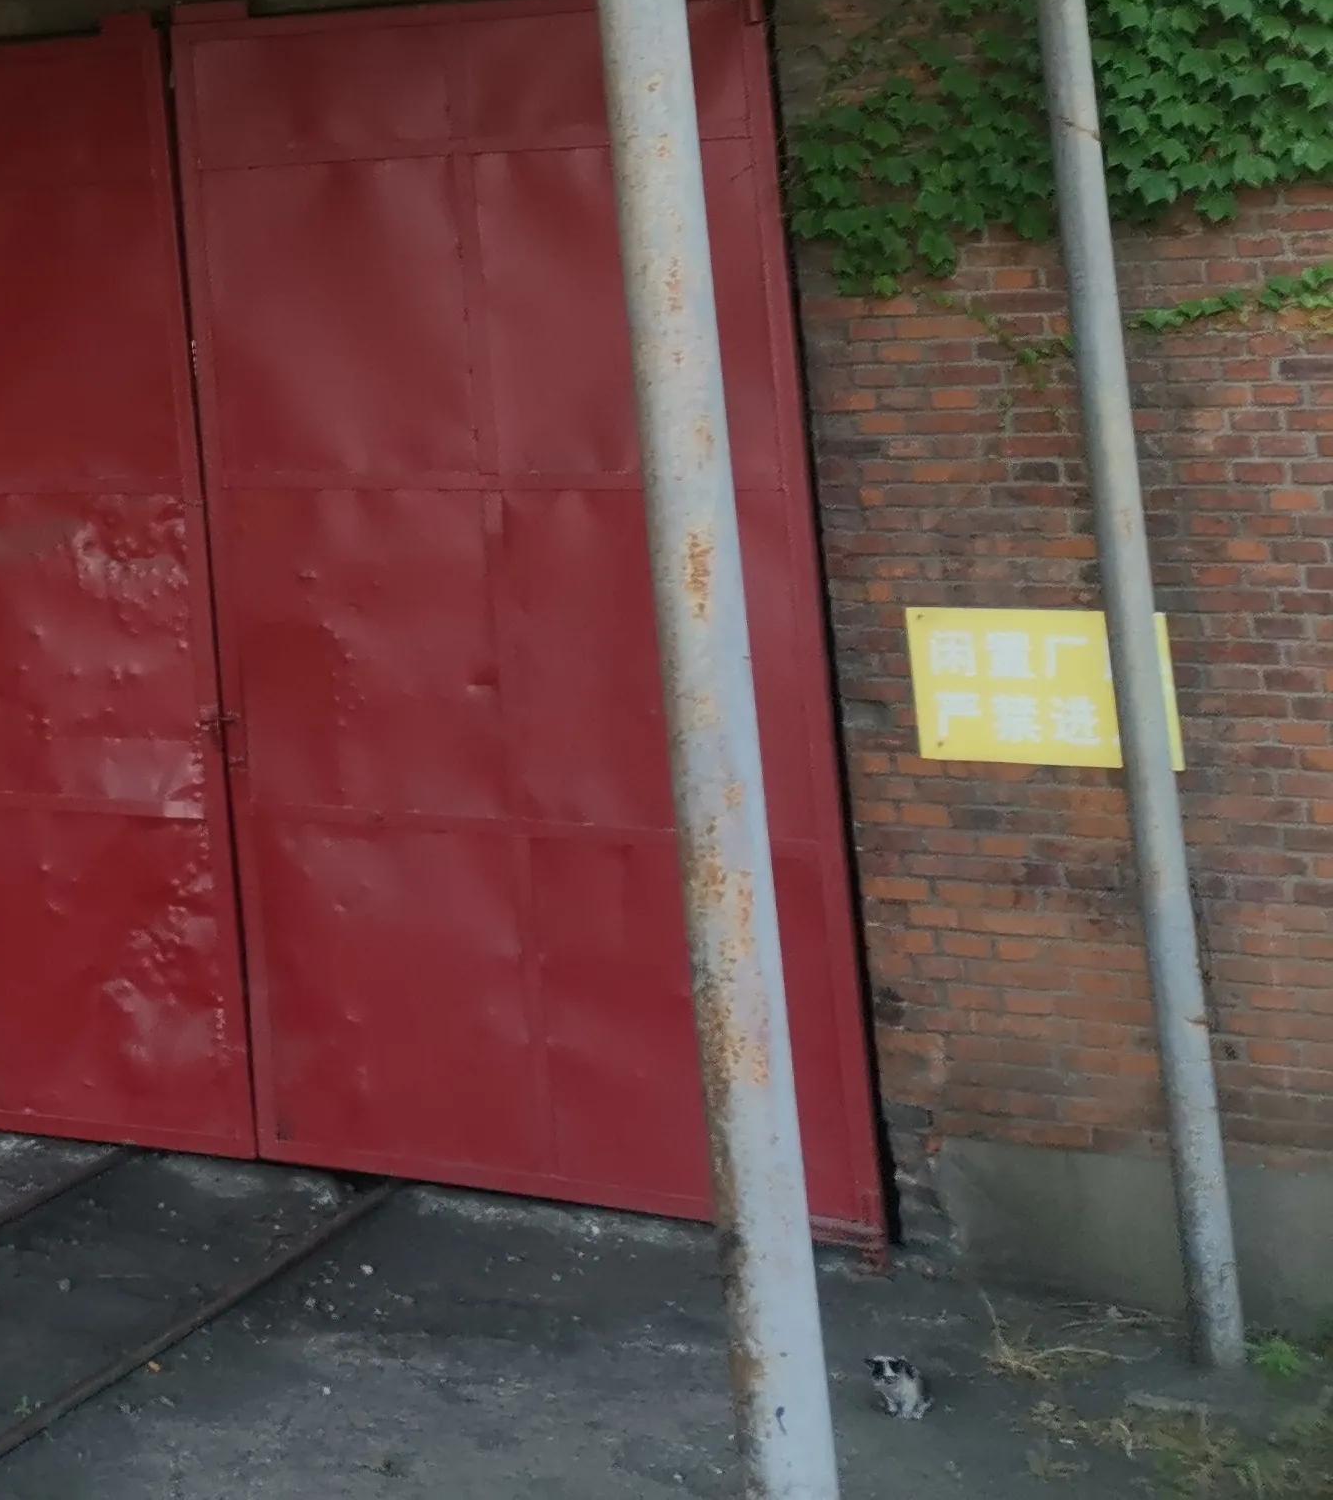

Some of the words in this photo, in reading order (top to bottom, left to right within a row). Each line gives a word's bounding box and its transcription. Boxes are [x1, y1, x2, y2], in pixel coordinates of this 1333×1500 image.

[929, 630, 1113, 683] 闲置厂
[934, 691, 1120, 746] 严禁进
